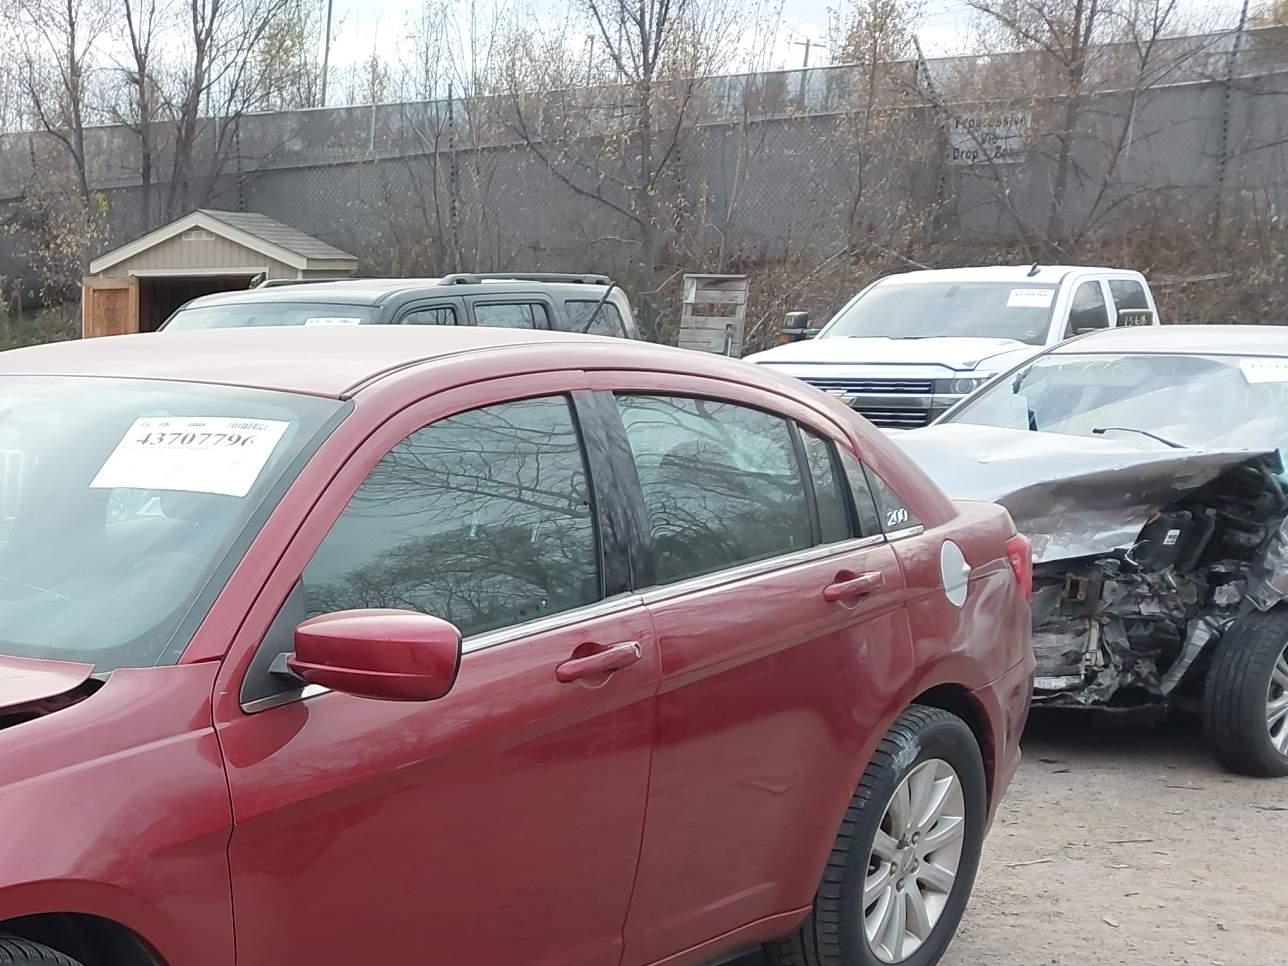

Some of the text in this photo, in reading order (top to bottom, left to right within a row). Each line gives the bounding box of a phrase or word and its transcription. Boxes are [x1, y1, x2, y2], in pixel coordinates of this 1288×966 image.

[952, 148, 979, 162] Drop
[135, 431, 258, 447] 43707796
[886, 508, 909, 527] 200
